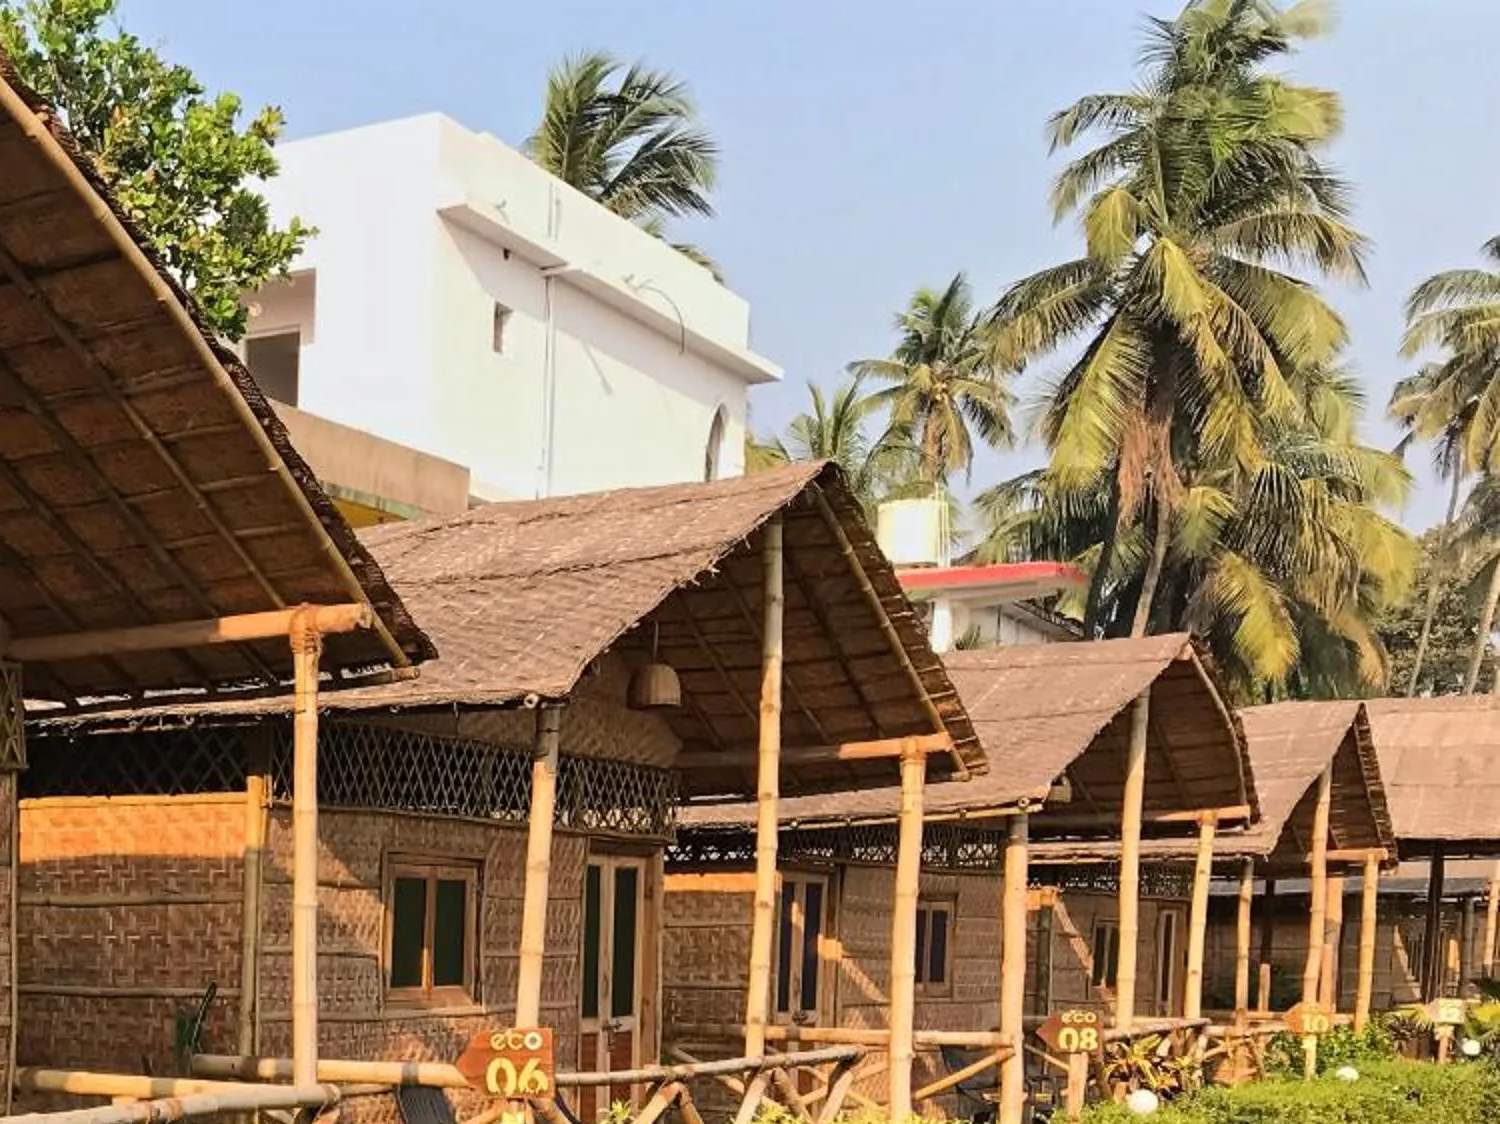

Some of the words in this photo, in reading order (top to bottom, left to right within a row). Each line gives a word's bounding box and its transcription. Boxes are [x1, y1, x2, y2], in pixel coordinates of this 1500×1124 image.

[1061, 1011, 1097, 1023] eco
[1301, 1013, 1329, 1033] 10
[490, 1032, 543, 1050] eco
[1059, 1027, 1098, 1052] 08
[486, 1057, 549, 1095] 06
